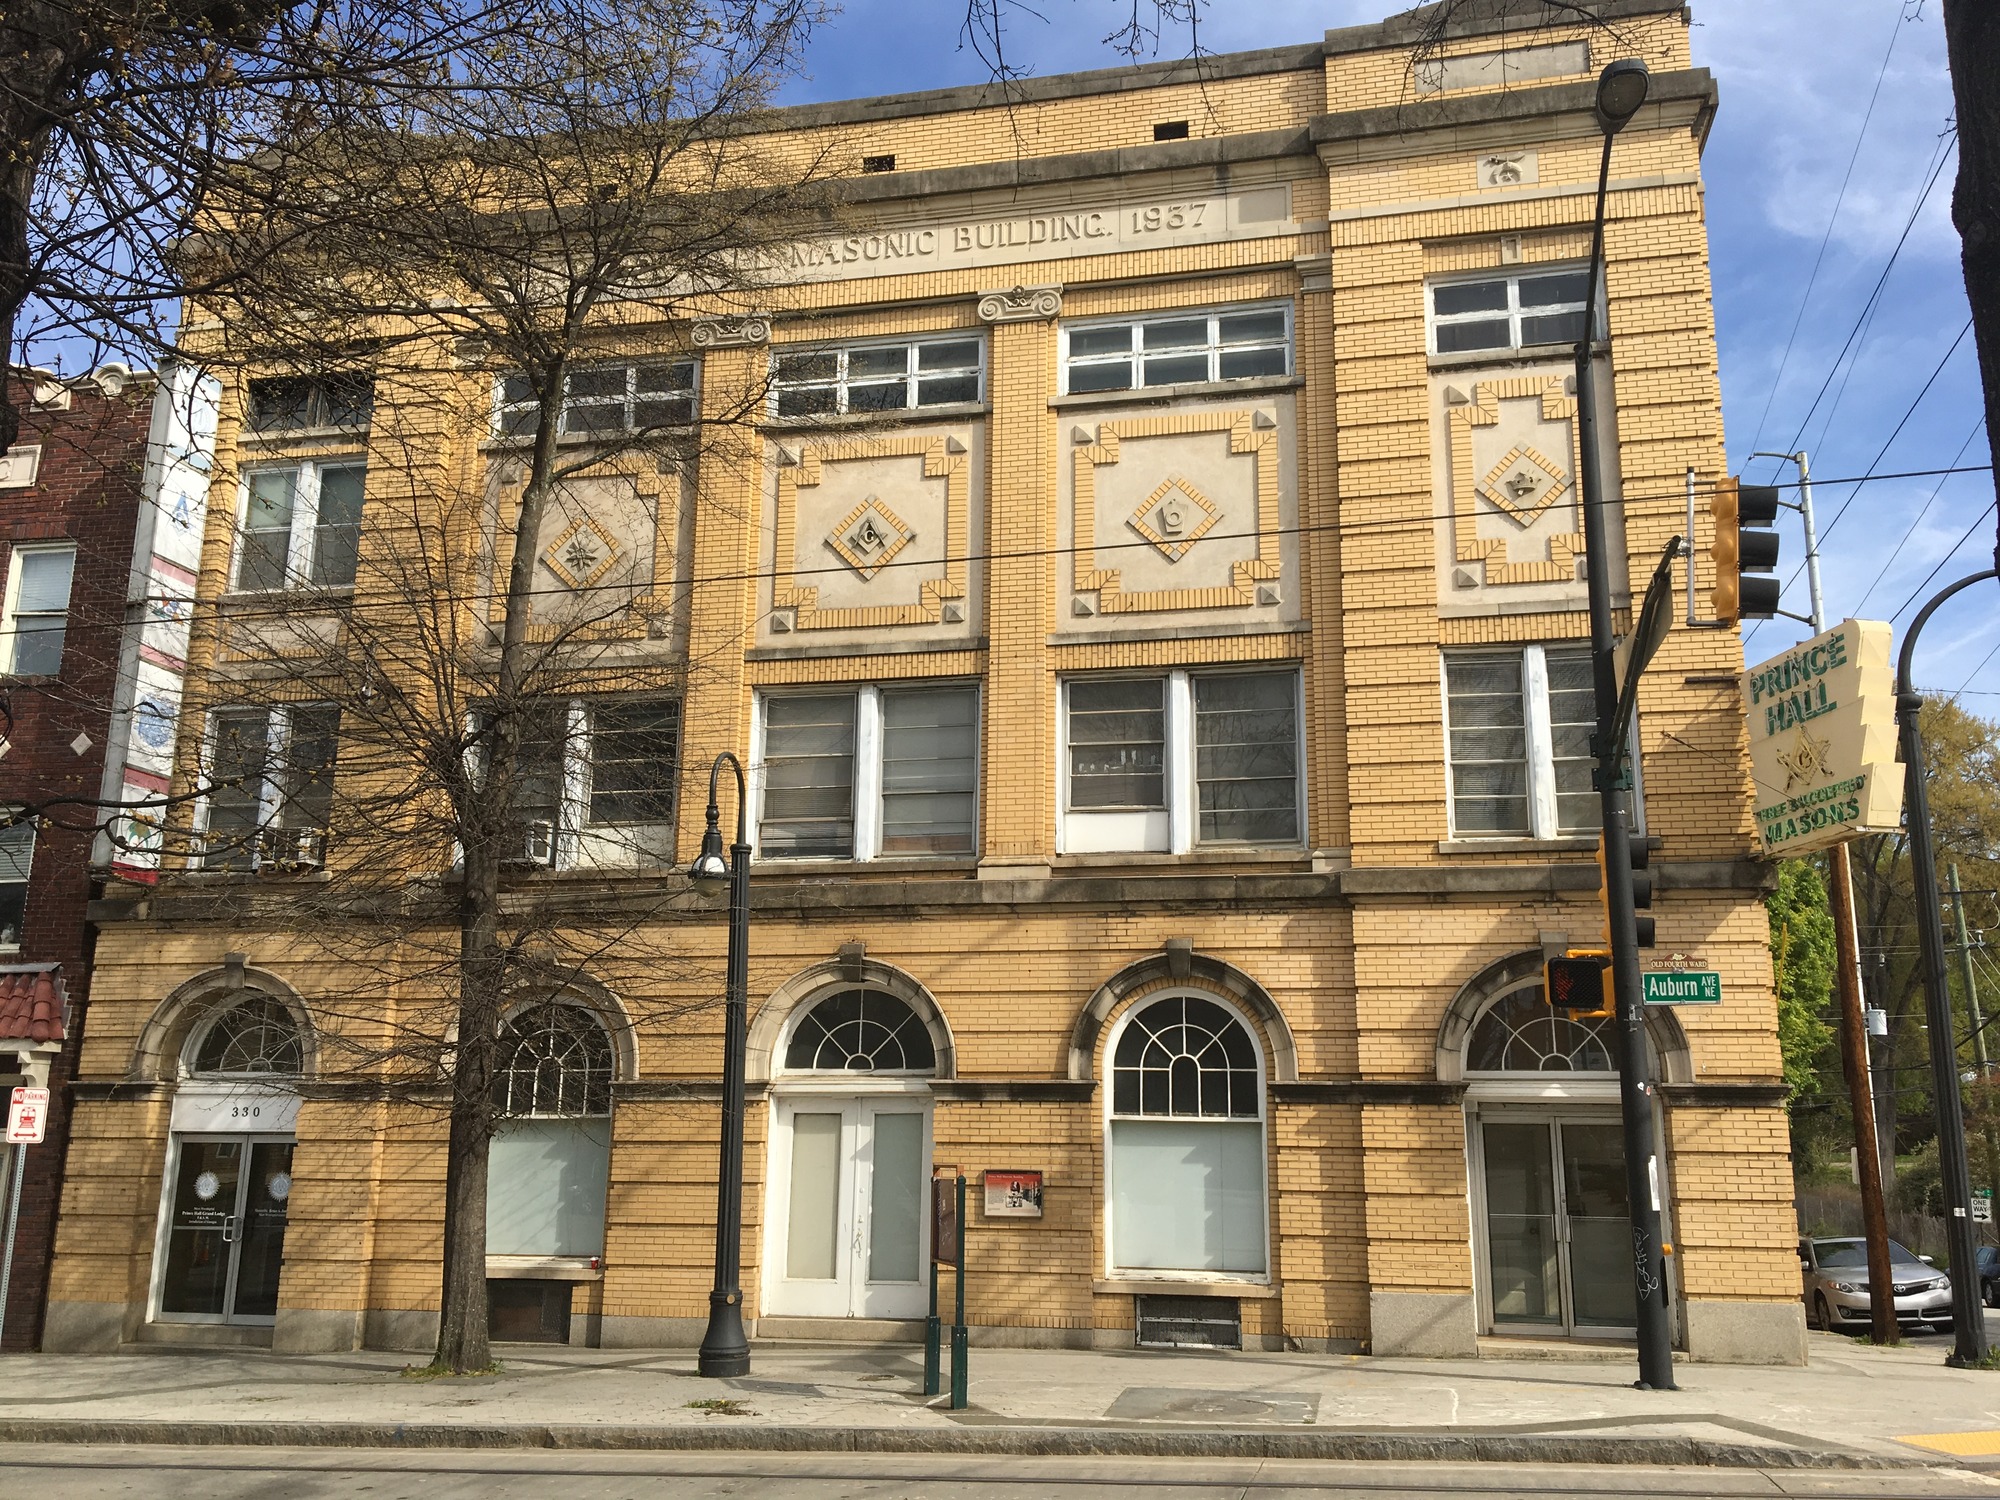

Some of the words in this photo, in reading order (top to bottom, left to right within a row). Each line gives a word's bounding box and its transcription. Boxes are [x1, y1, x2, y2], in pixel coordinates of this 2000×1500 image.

[790, 230, 936, 267] MASONIC
[1132, 203, 1209, 233] 1937
[1750, 633, 1847, 705] PRINCE
[1765, 683, 1837, 736] HALL
[1765, 797, 1860, 845] MASONS
[1649, 977, 1698, 996] Auburn
[1701, 976, 1716, 986] AVE
[1705, 987, 1716, 997] NE
[13, 1091, 24, 1102] NO
[24, 1093, 47, 1101] PARKING
[232, 1106, 260, 1118] 330
